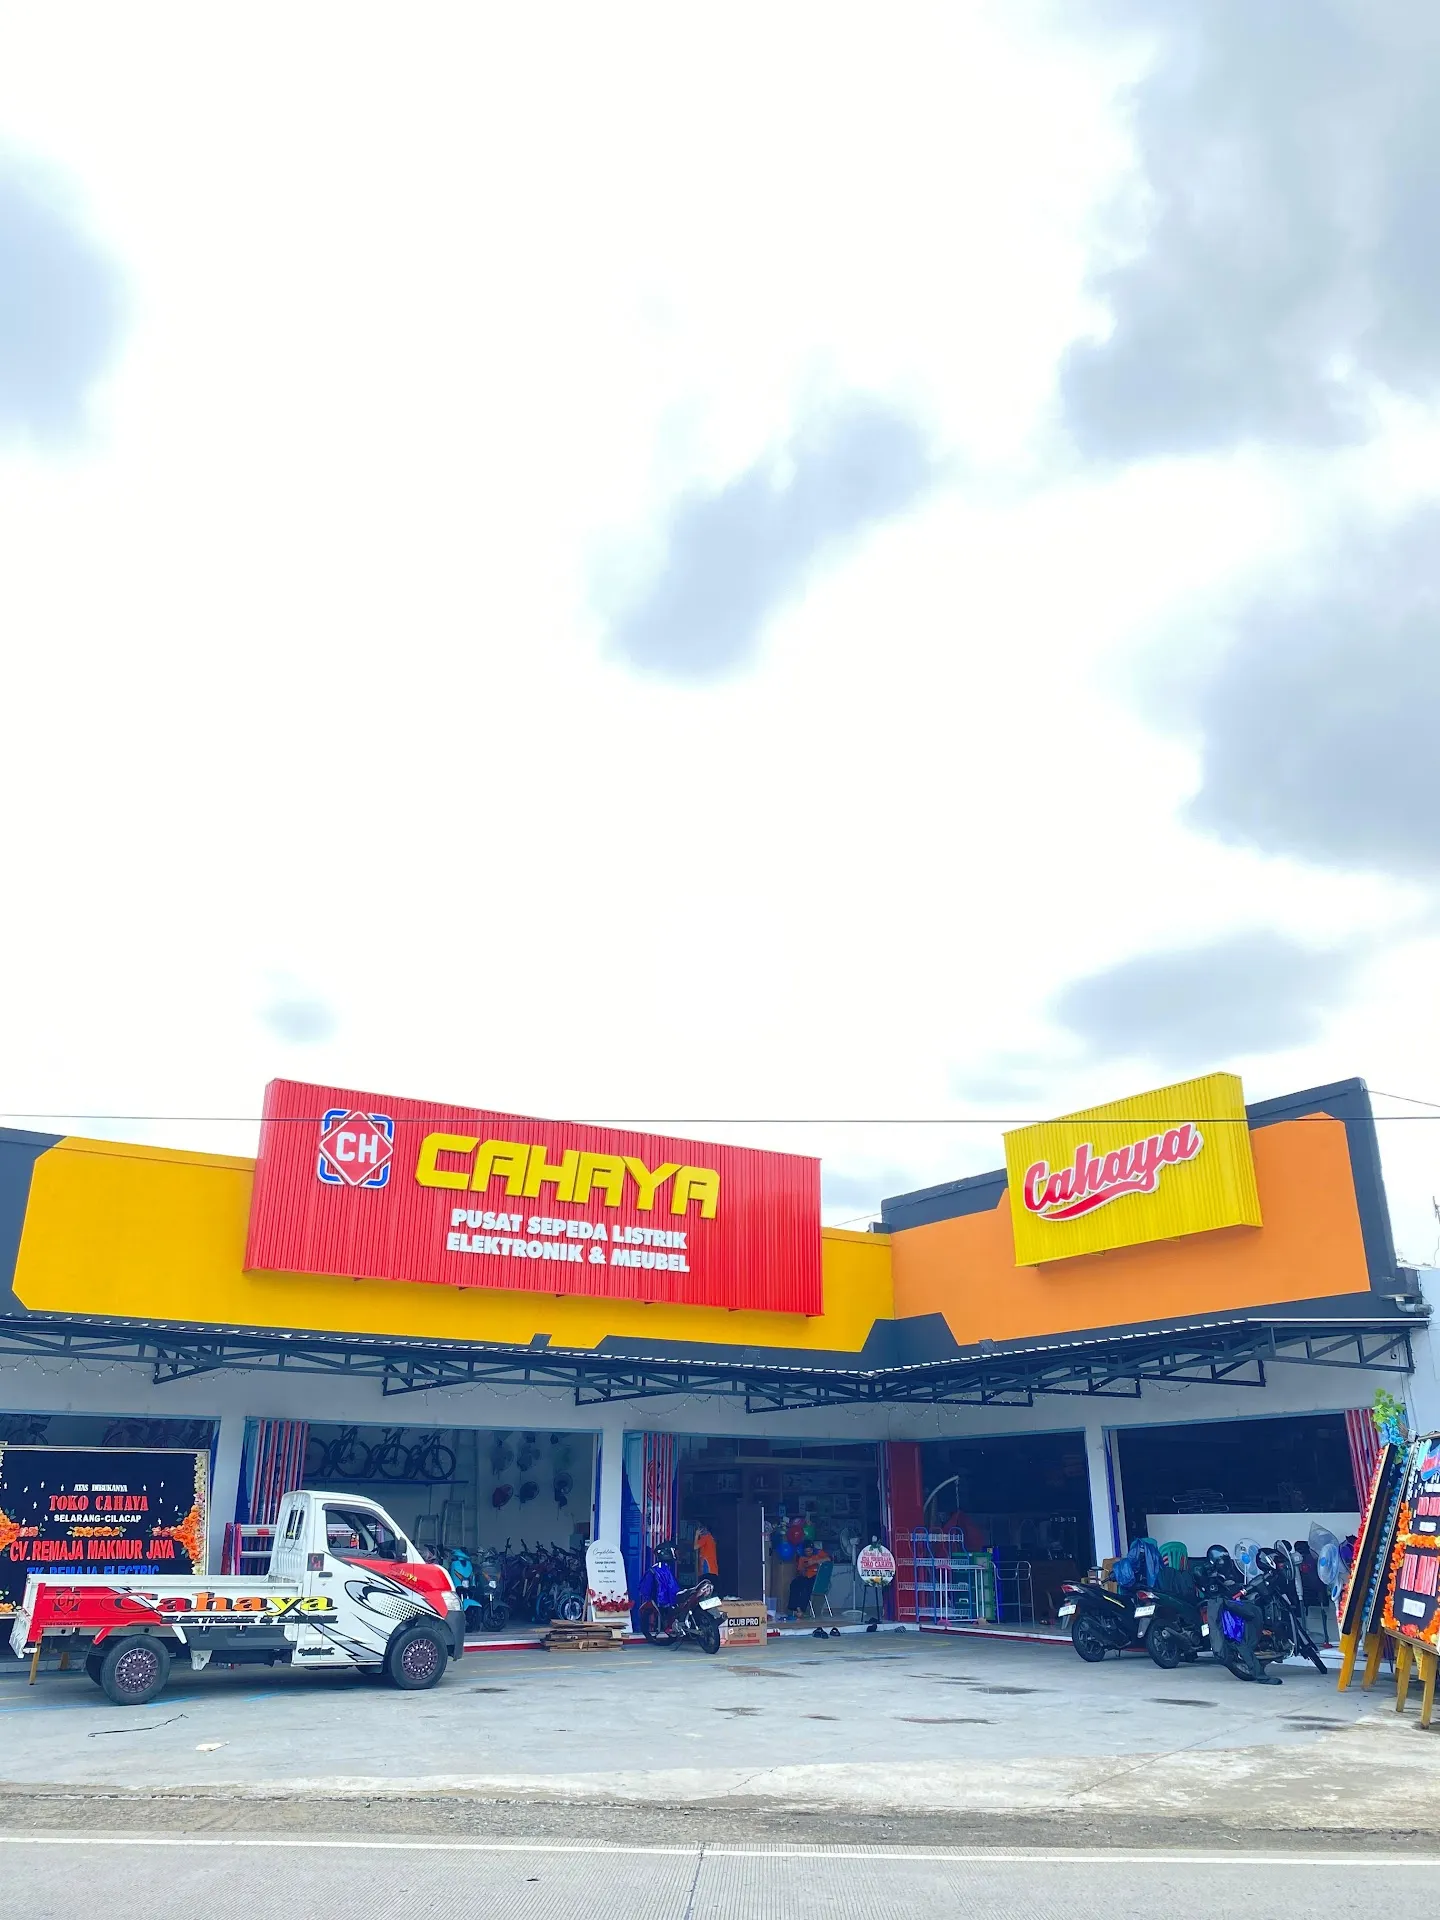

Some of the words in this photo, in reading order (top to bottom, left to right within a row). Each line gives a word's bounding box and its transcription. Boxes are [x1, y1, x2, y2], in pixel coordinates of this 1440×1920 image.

[335, 1131, 378, 1164] CH
[415, 1132, 721, 1219] CAHAYA
[1023, 1122, 1204, 1222] Cahaya
[451, 1208, 523, 1232] PUSAT
[527, 1216, 608, 1241] SEPEDA
[612, 1225, 687, 1249] LISTRIK
[446, 1232, 583, 1262] ELEKTRONIK
[588, 1246, 606, 1264] &
[610, 1249, 690, 1272] MEUBEL
[49, 1495, 89, 1511] TOKO
[95, 1495, 149, 1511] CAHAYA
[54, 1514, 142, 1523] SELARANG-CILACAP
[87, 1540, 143, 1560] MAKMUR
[146, 1540, 175, 1559] JAYA
[100, 1591, 338, 1616] Cahaya
[728, 1618, 745, 1626] CLUB
[746, 1618, 759, 1626] PRO
